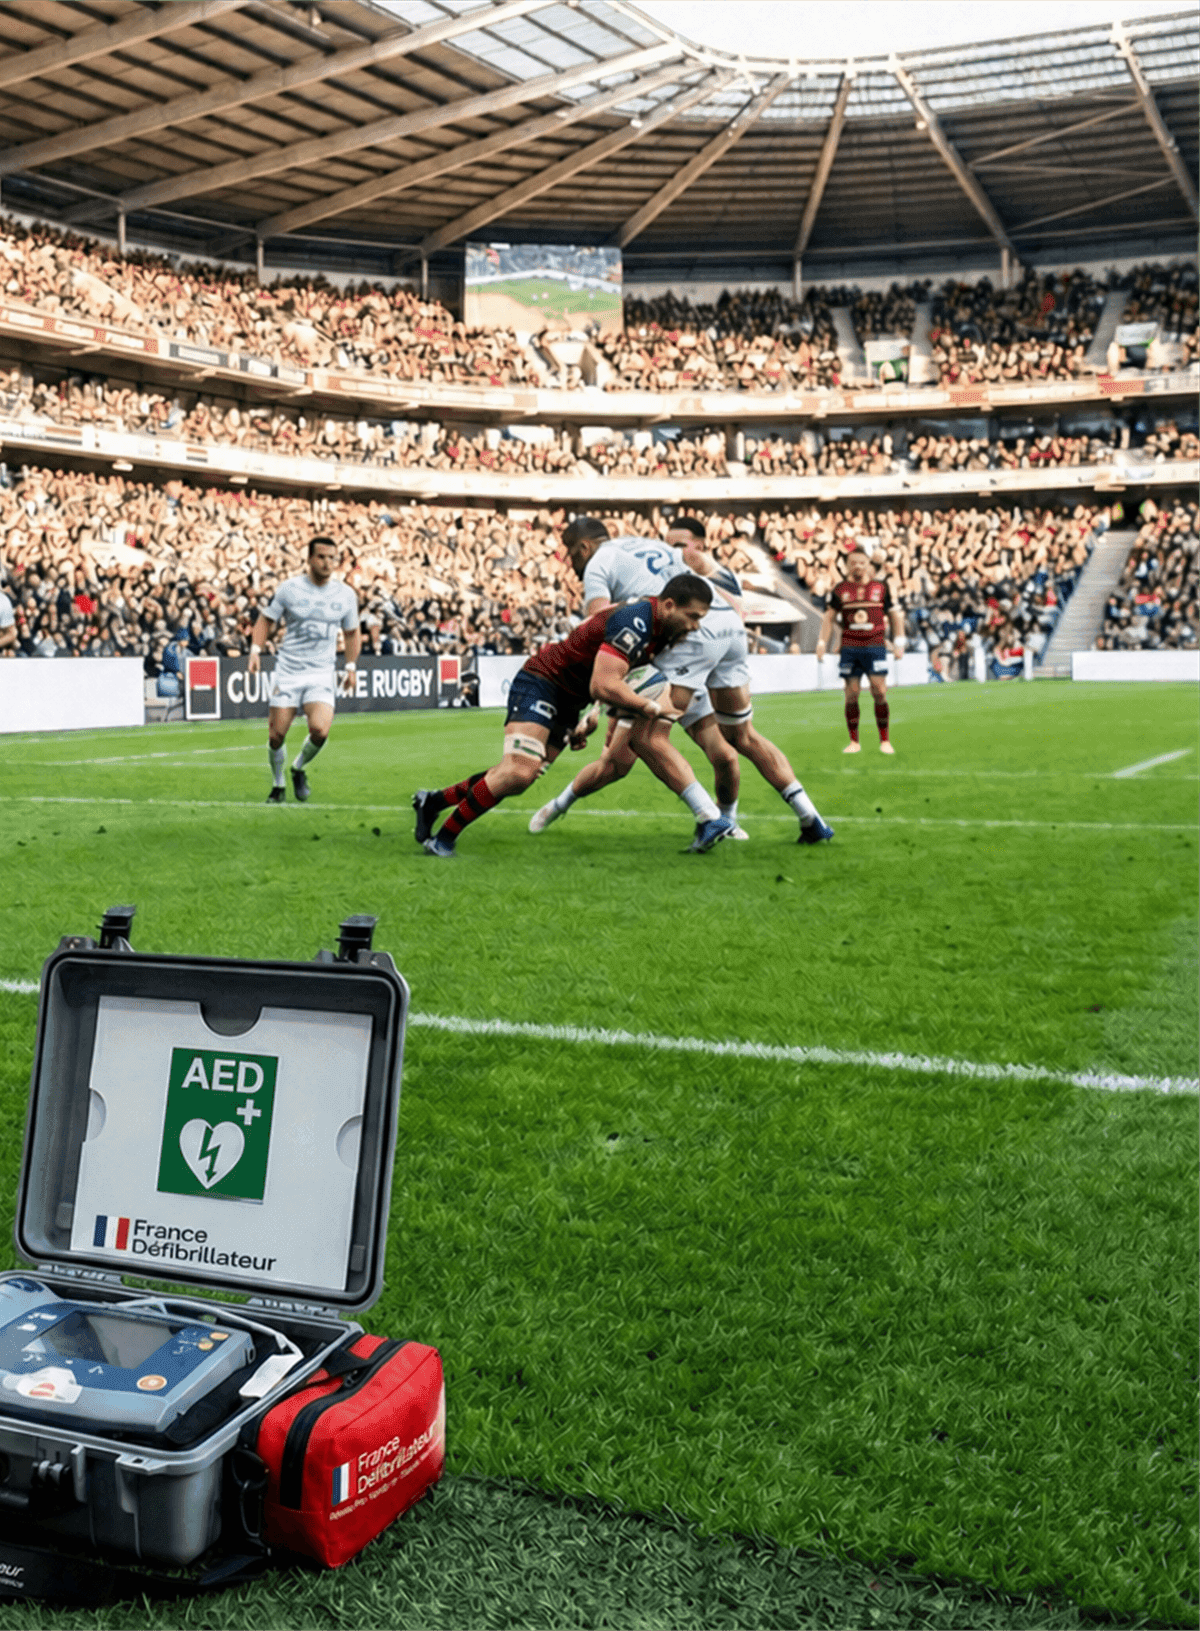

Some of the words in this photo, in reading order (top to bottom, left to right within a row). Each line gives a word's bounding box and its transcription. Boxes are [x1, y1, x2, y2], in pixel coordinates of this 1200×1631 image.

[372, 668, 433, 698] RUGBY
[181, 1057, 264, 1094] AED
[133, 1219, 208, 1243] France
[132, 1238, 277, 1271] Défibrillateur
[358, 1436, 400, 1473] France
